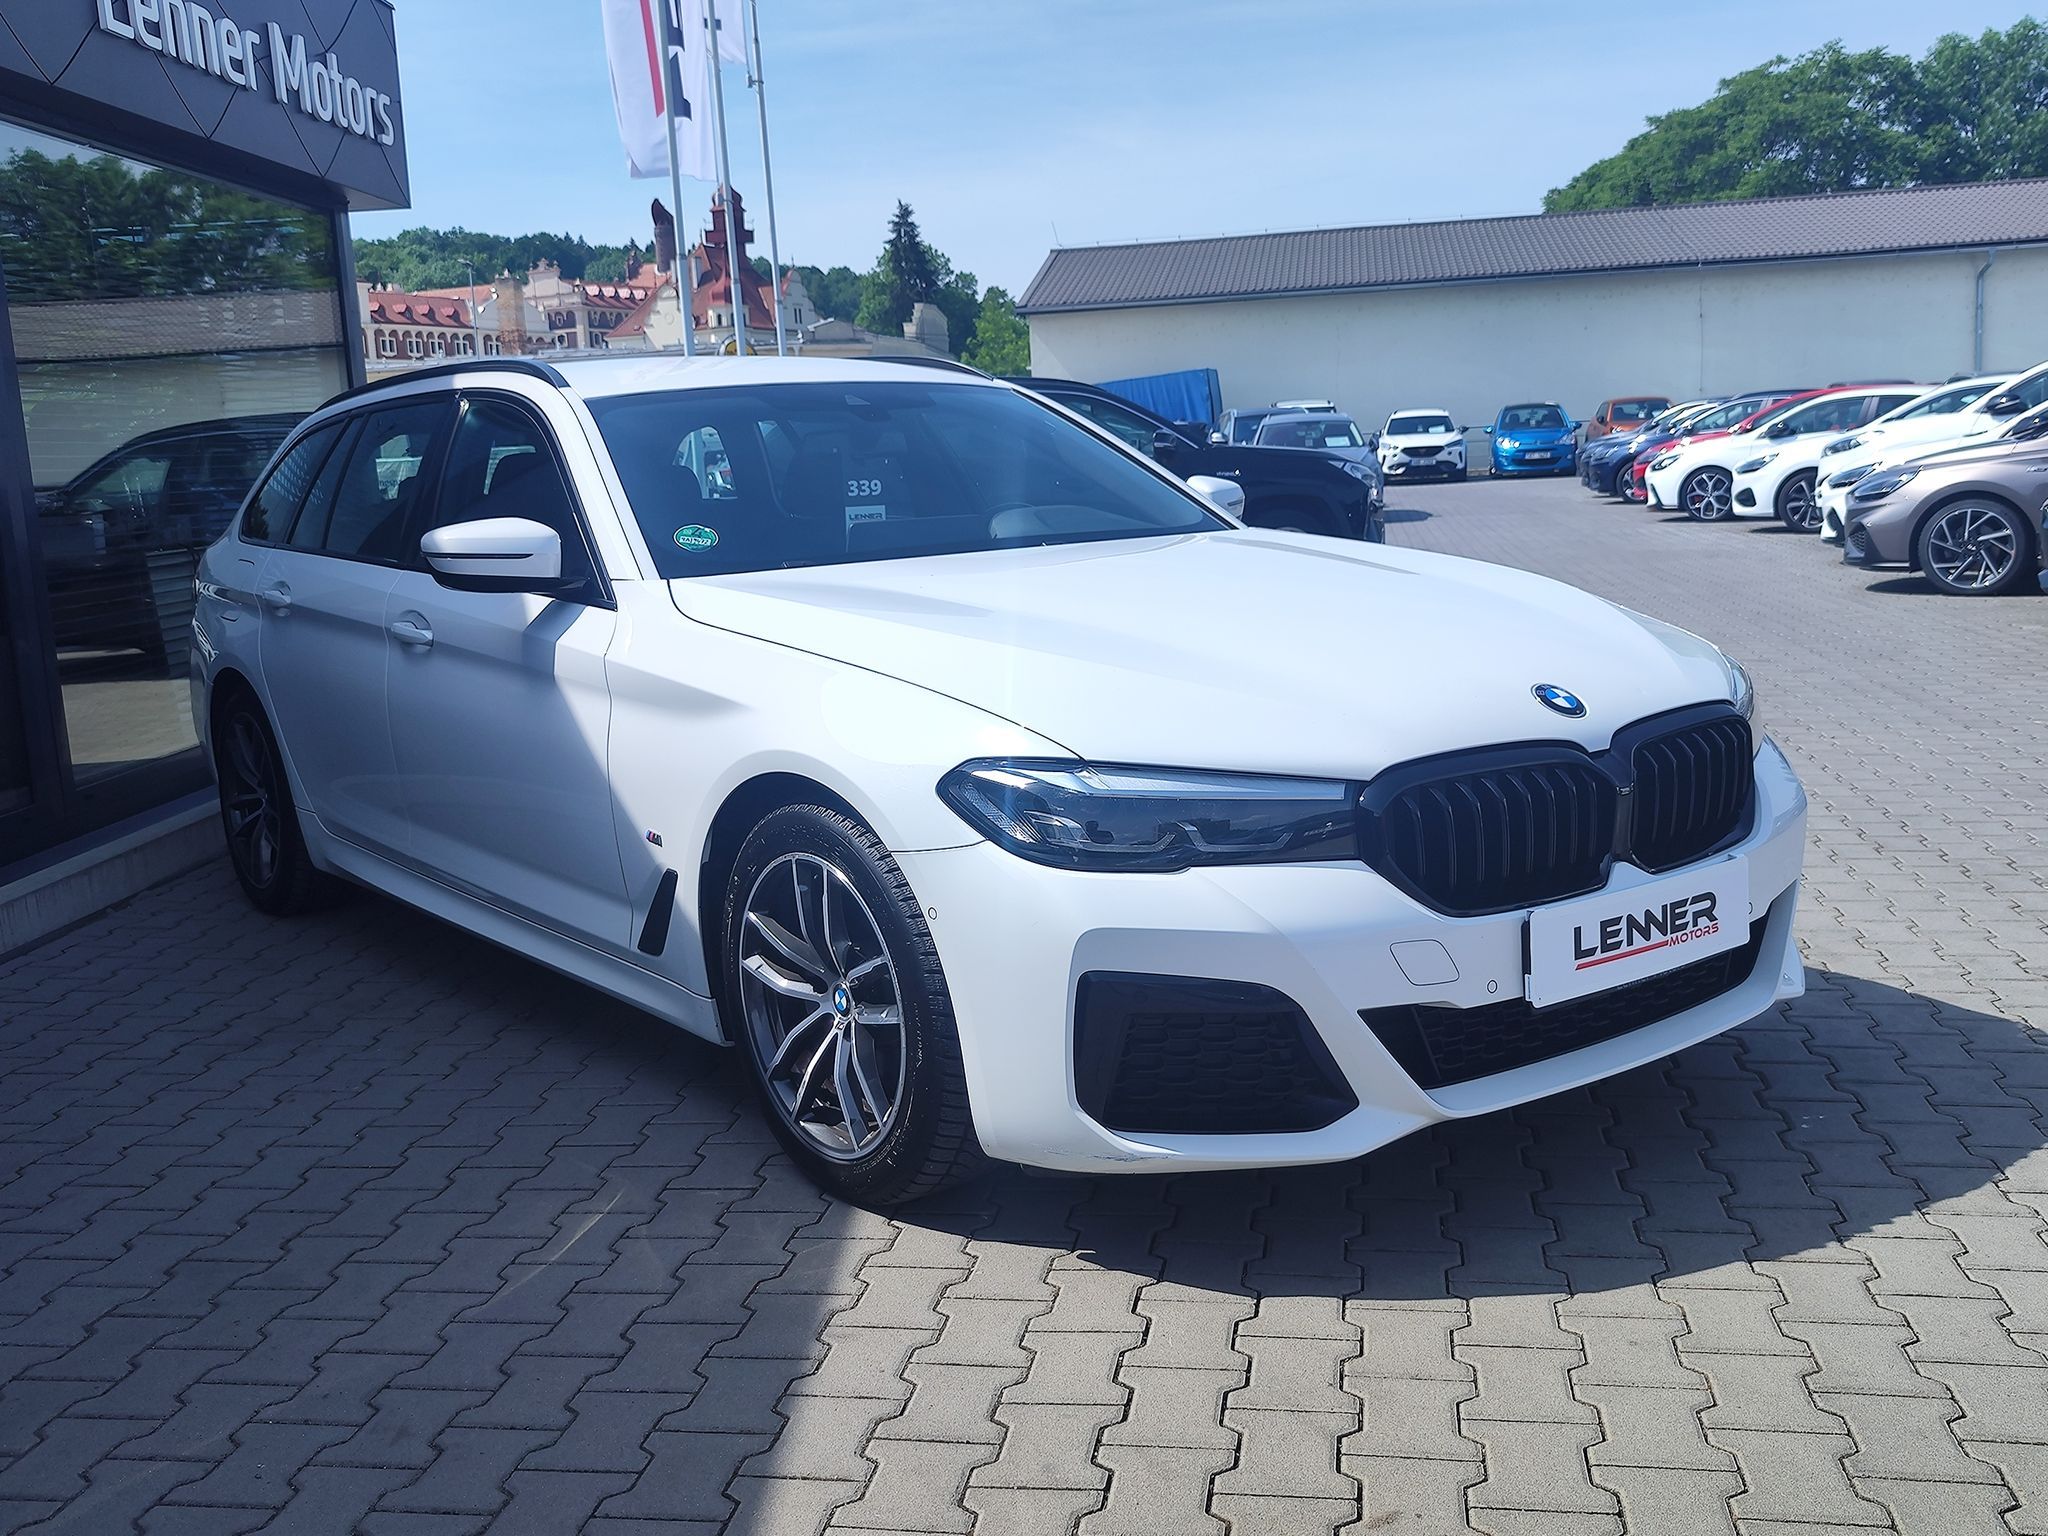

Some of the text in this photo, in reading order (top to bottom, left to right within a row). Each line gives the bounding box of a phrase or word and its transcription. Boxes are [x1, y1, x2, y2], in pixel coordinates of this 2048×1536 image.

[97, 0, 395, 146] Lenner Motors
[847, 479, 882, 496] 339
[1573, 891, 1719, 961] LENNER
[1669, 923, 1719, 946] MOTORS
